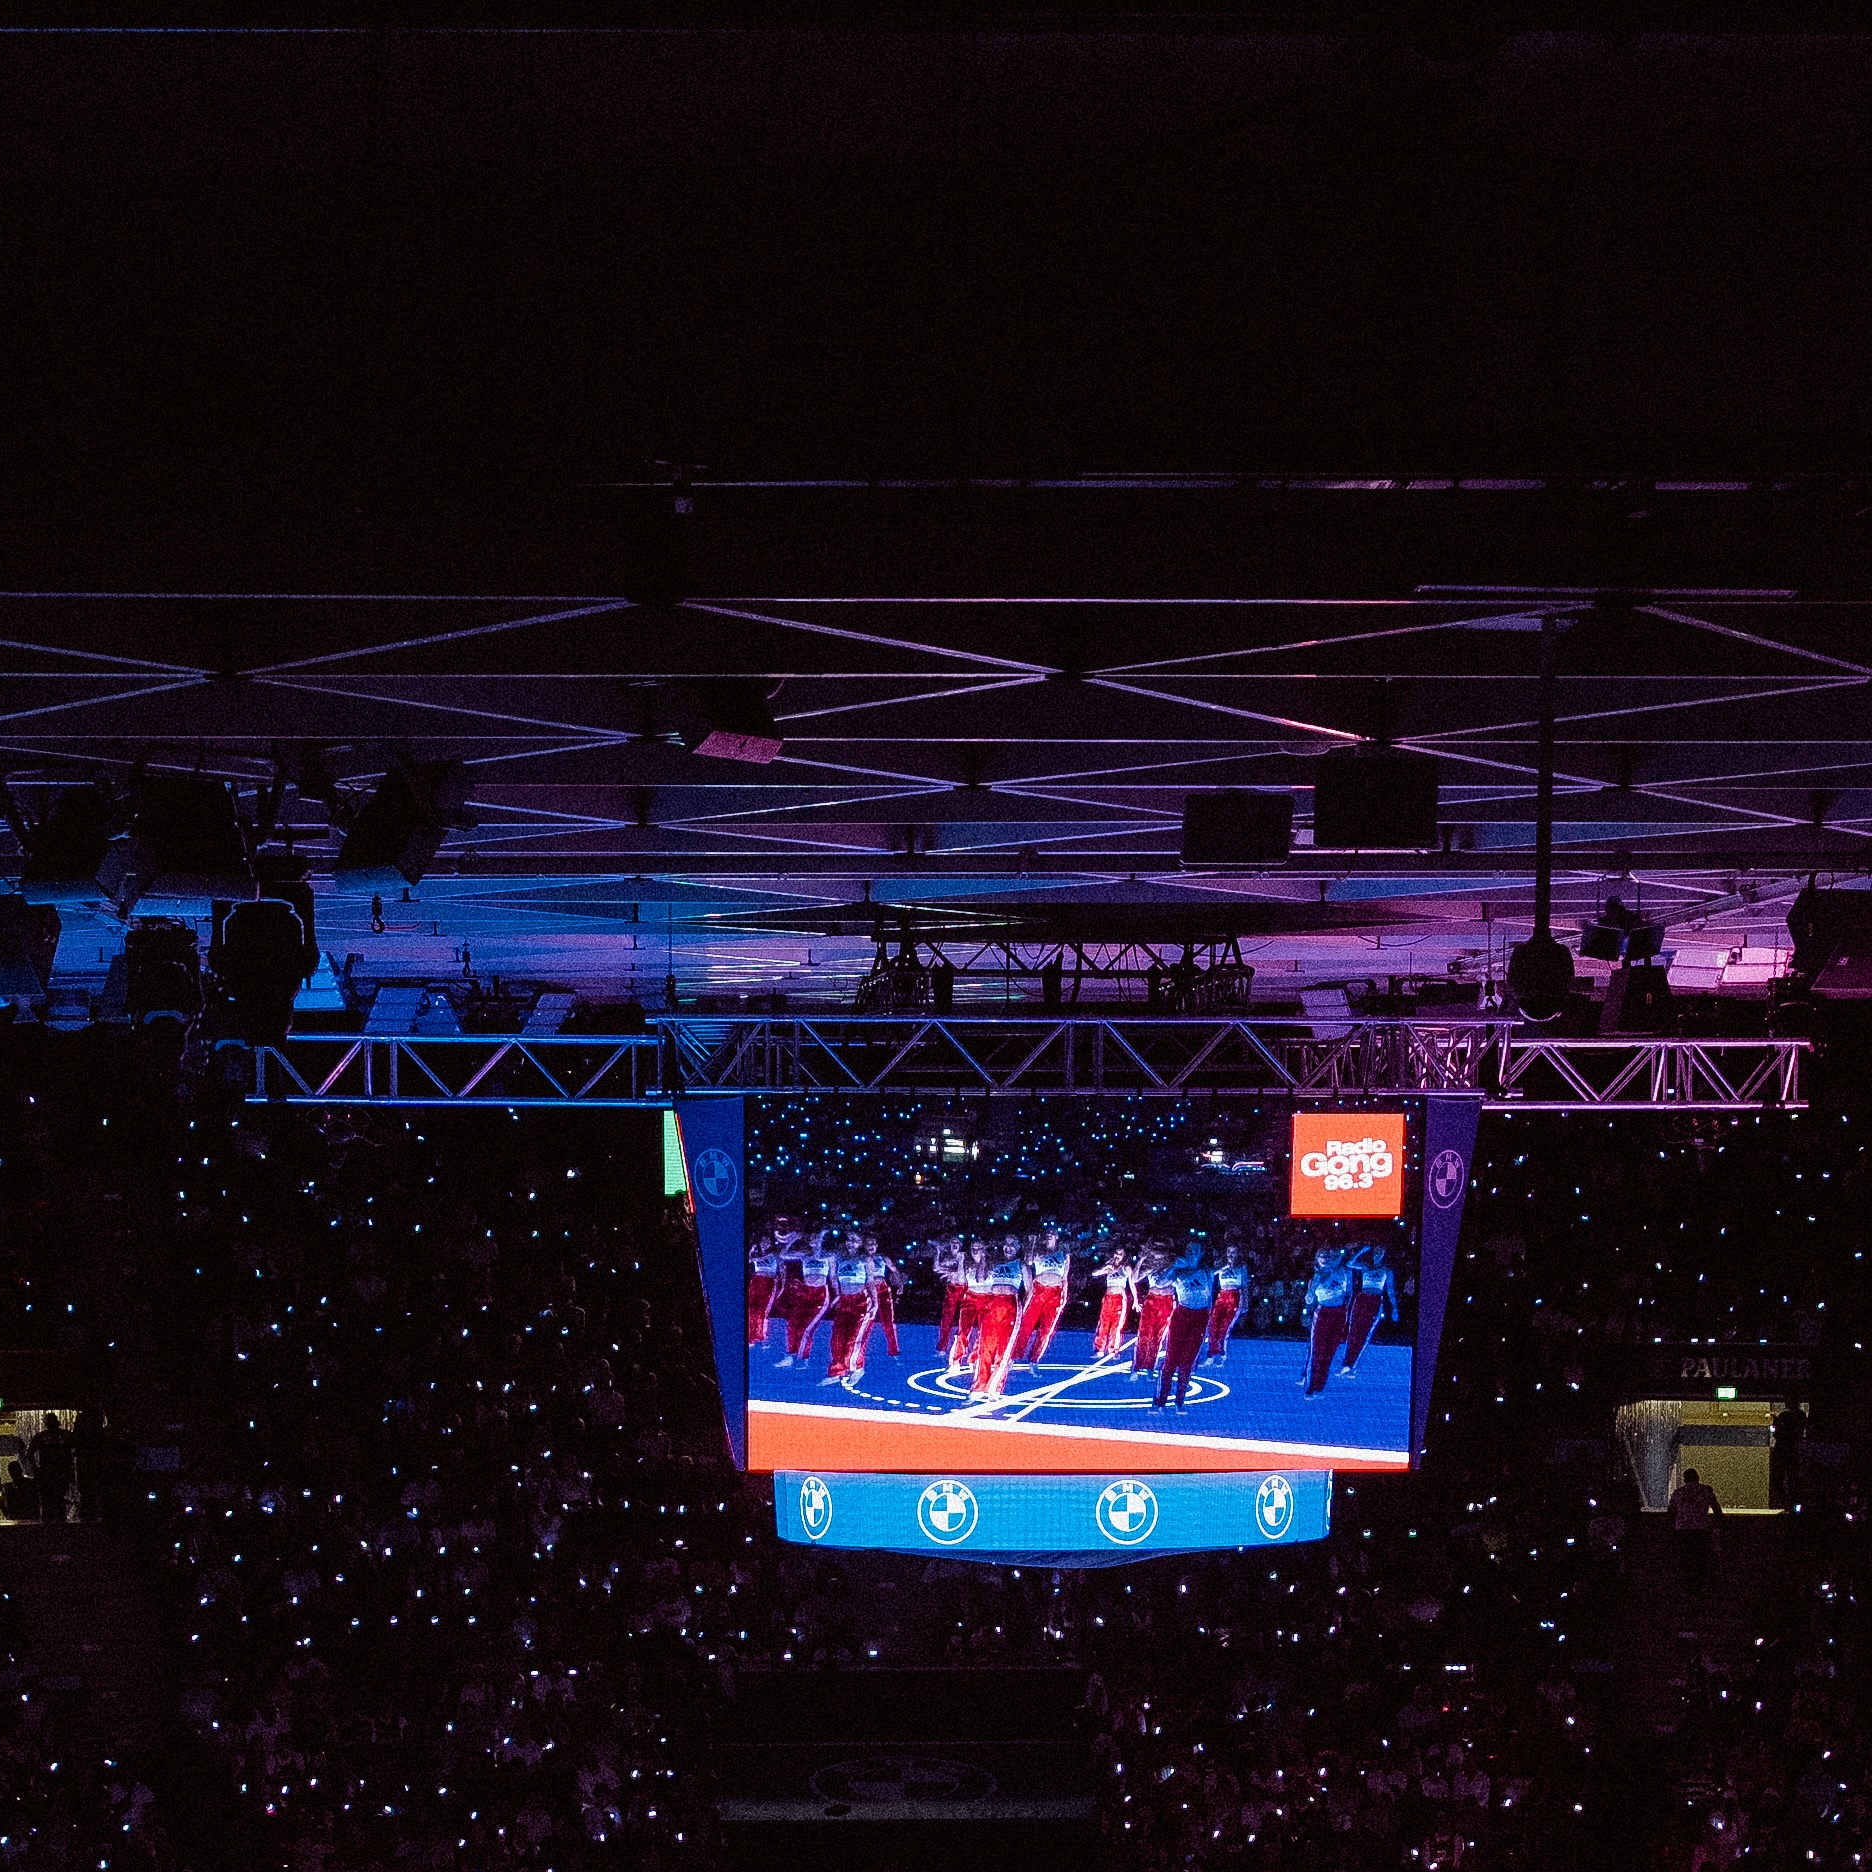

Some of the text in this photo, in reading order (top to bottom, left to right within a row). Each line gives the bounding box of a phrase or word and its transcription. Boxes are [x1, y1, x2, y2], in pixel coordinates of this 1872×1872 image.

[1326, 1138, 1387, 1156] Radio
[1301, 1152, 1393, 1178] Gong
[1324, 1173, 1374, 1191] 96.3
